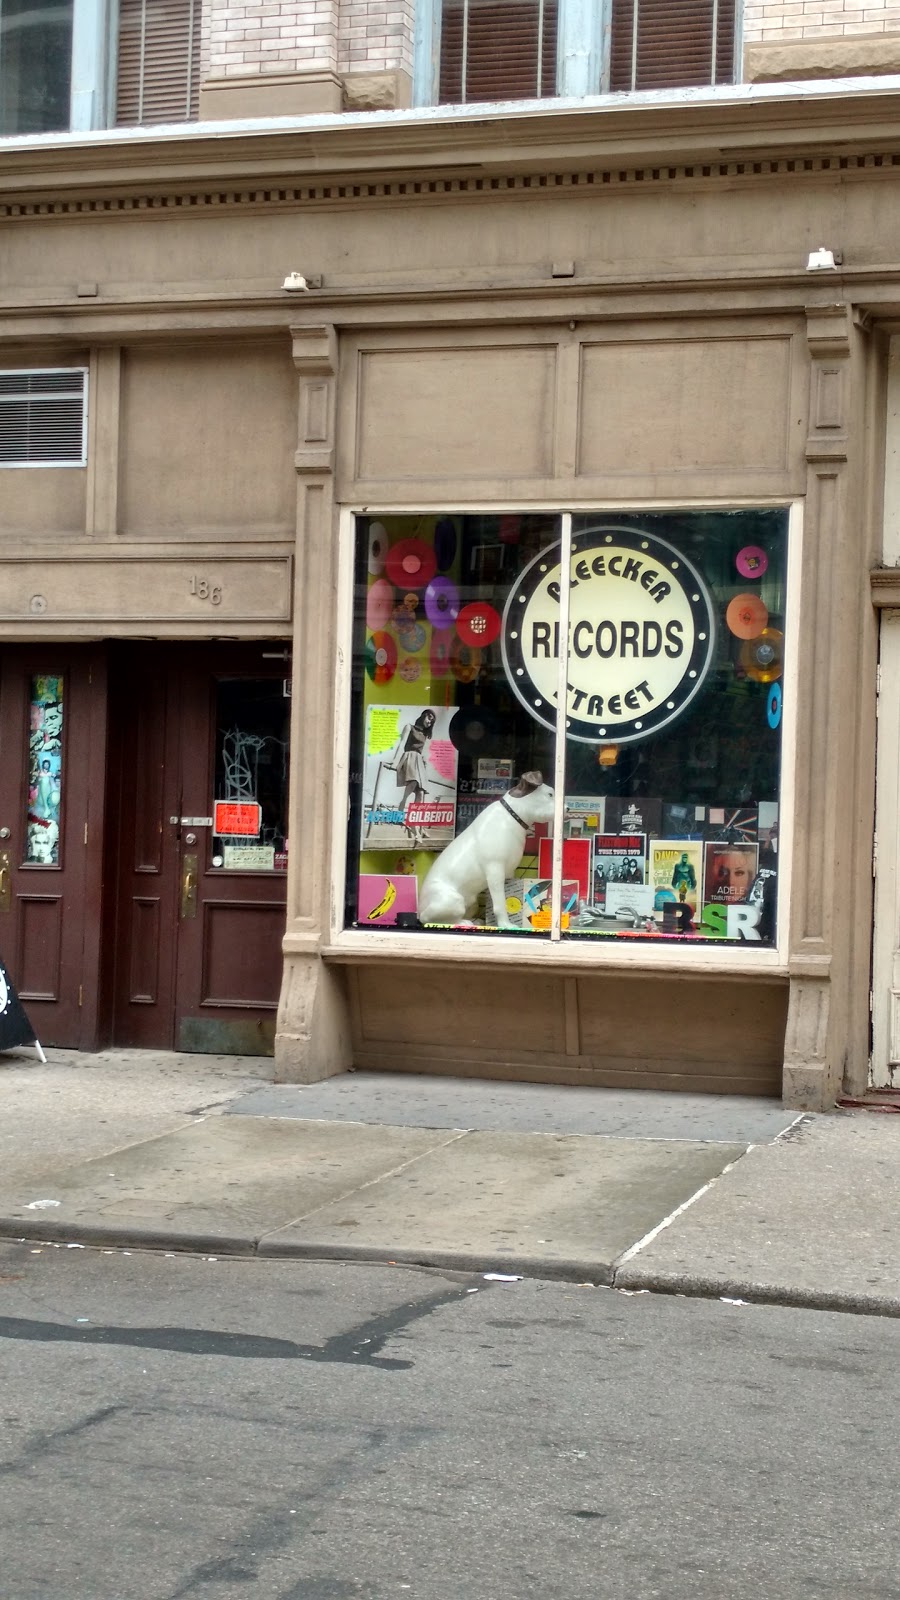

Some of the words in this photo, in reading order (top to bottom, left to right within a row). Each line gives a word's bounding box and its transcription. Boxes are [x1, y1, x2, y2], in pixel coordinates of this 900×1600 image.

[189, 576, 222, 605] 186
[408, 811, 454, 823] GILBERTO
[717, 886, 745, 895] ADELE
